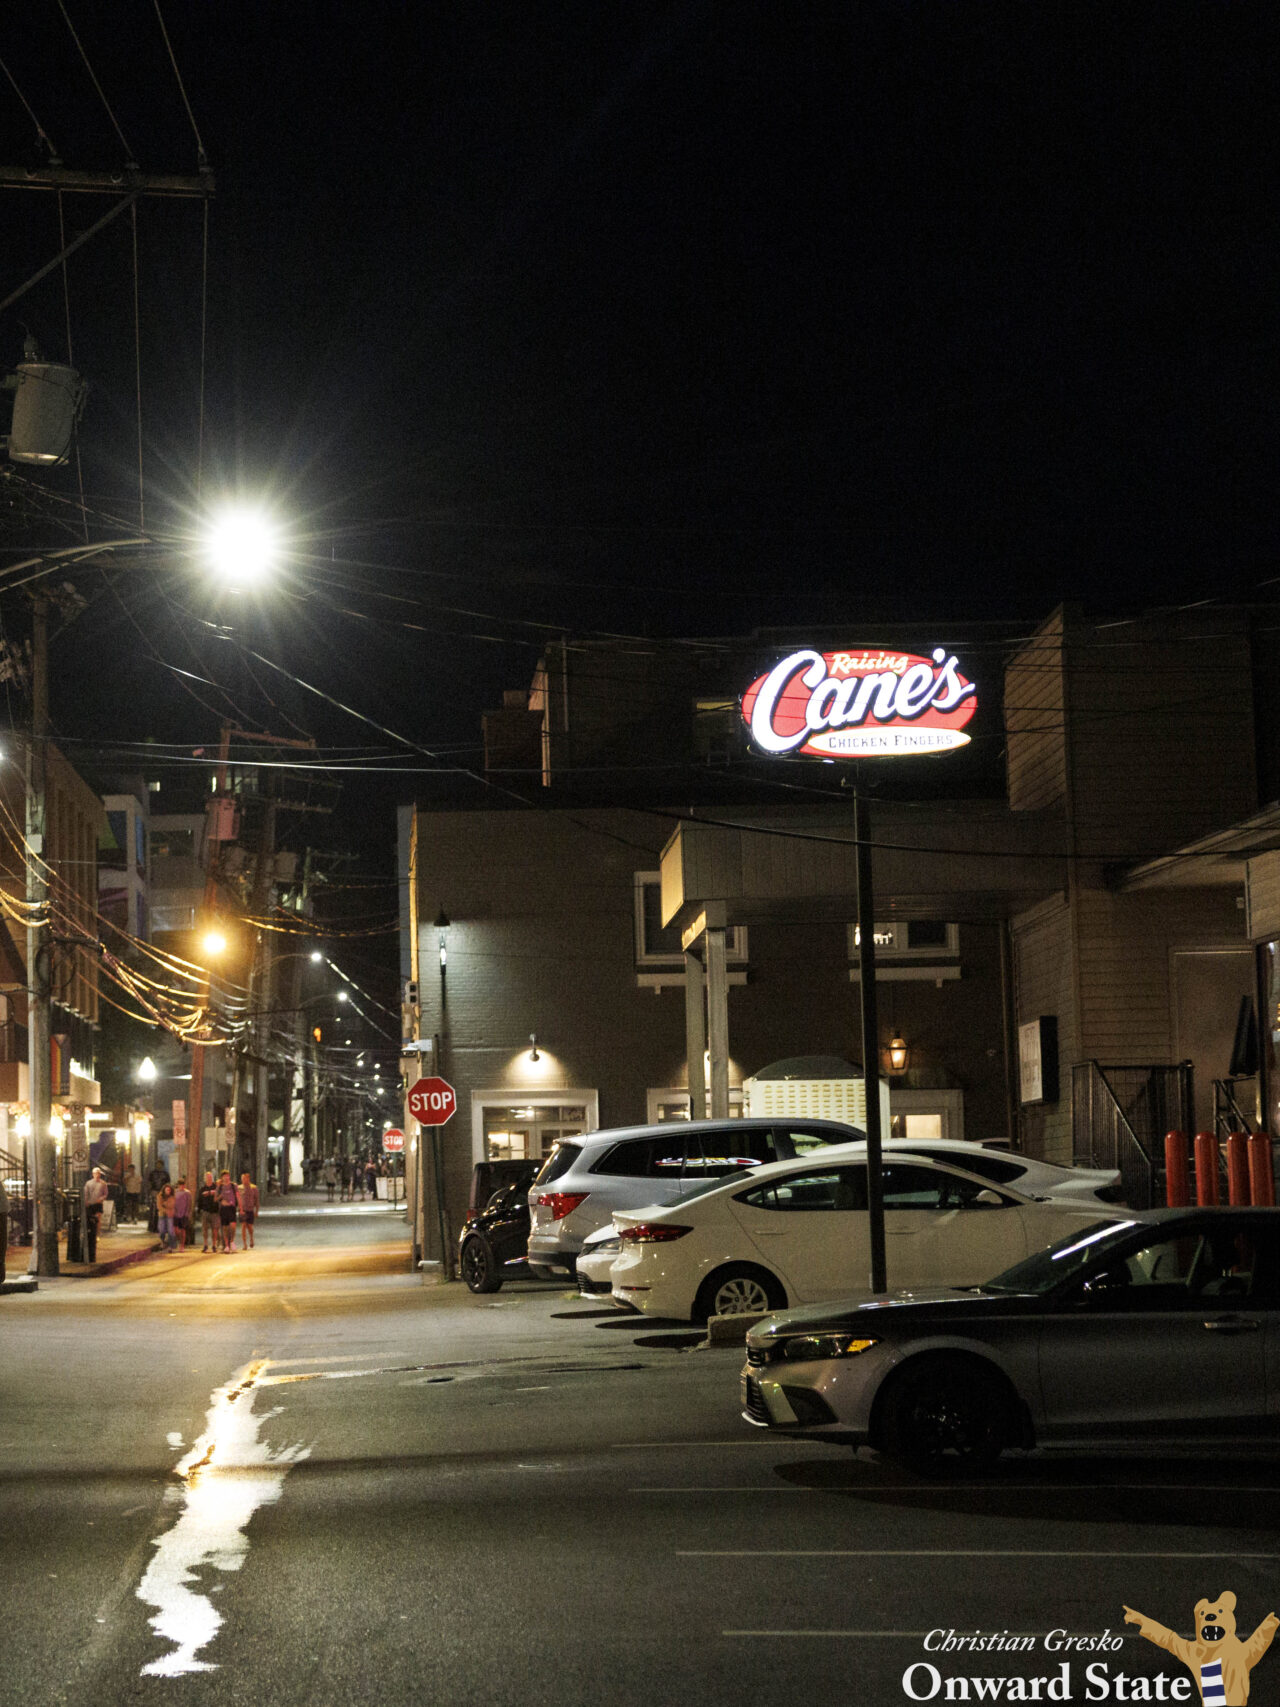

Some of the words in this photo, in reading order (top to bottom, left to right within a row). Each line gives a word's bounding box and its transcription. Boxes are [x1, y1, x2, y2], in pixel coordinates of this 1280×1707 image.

[830, 651, 909, 675] Raising
[751, 647, 976, 752] Cane's
[411, 1091, 452, 1112] STOP
